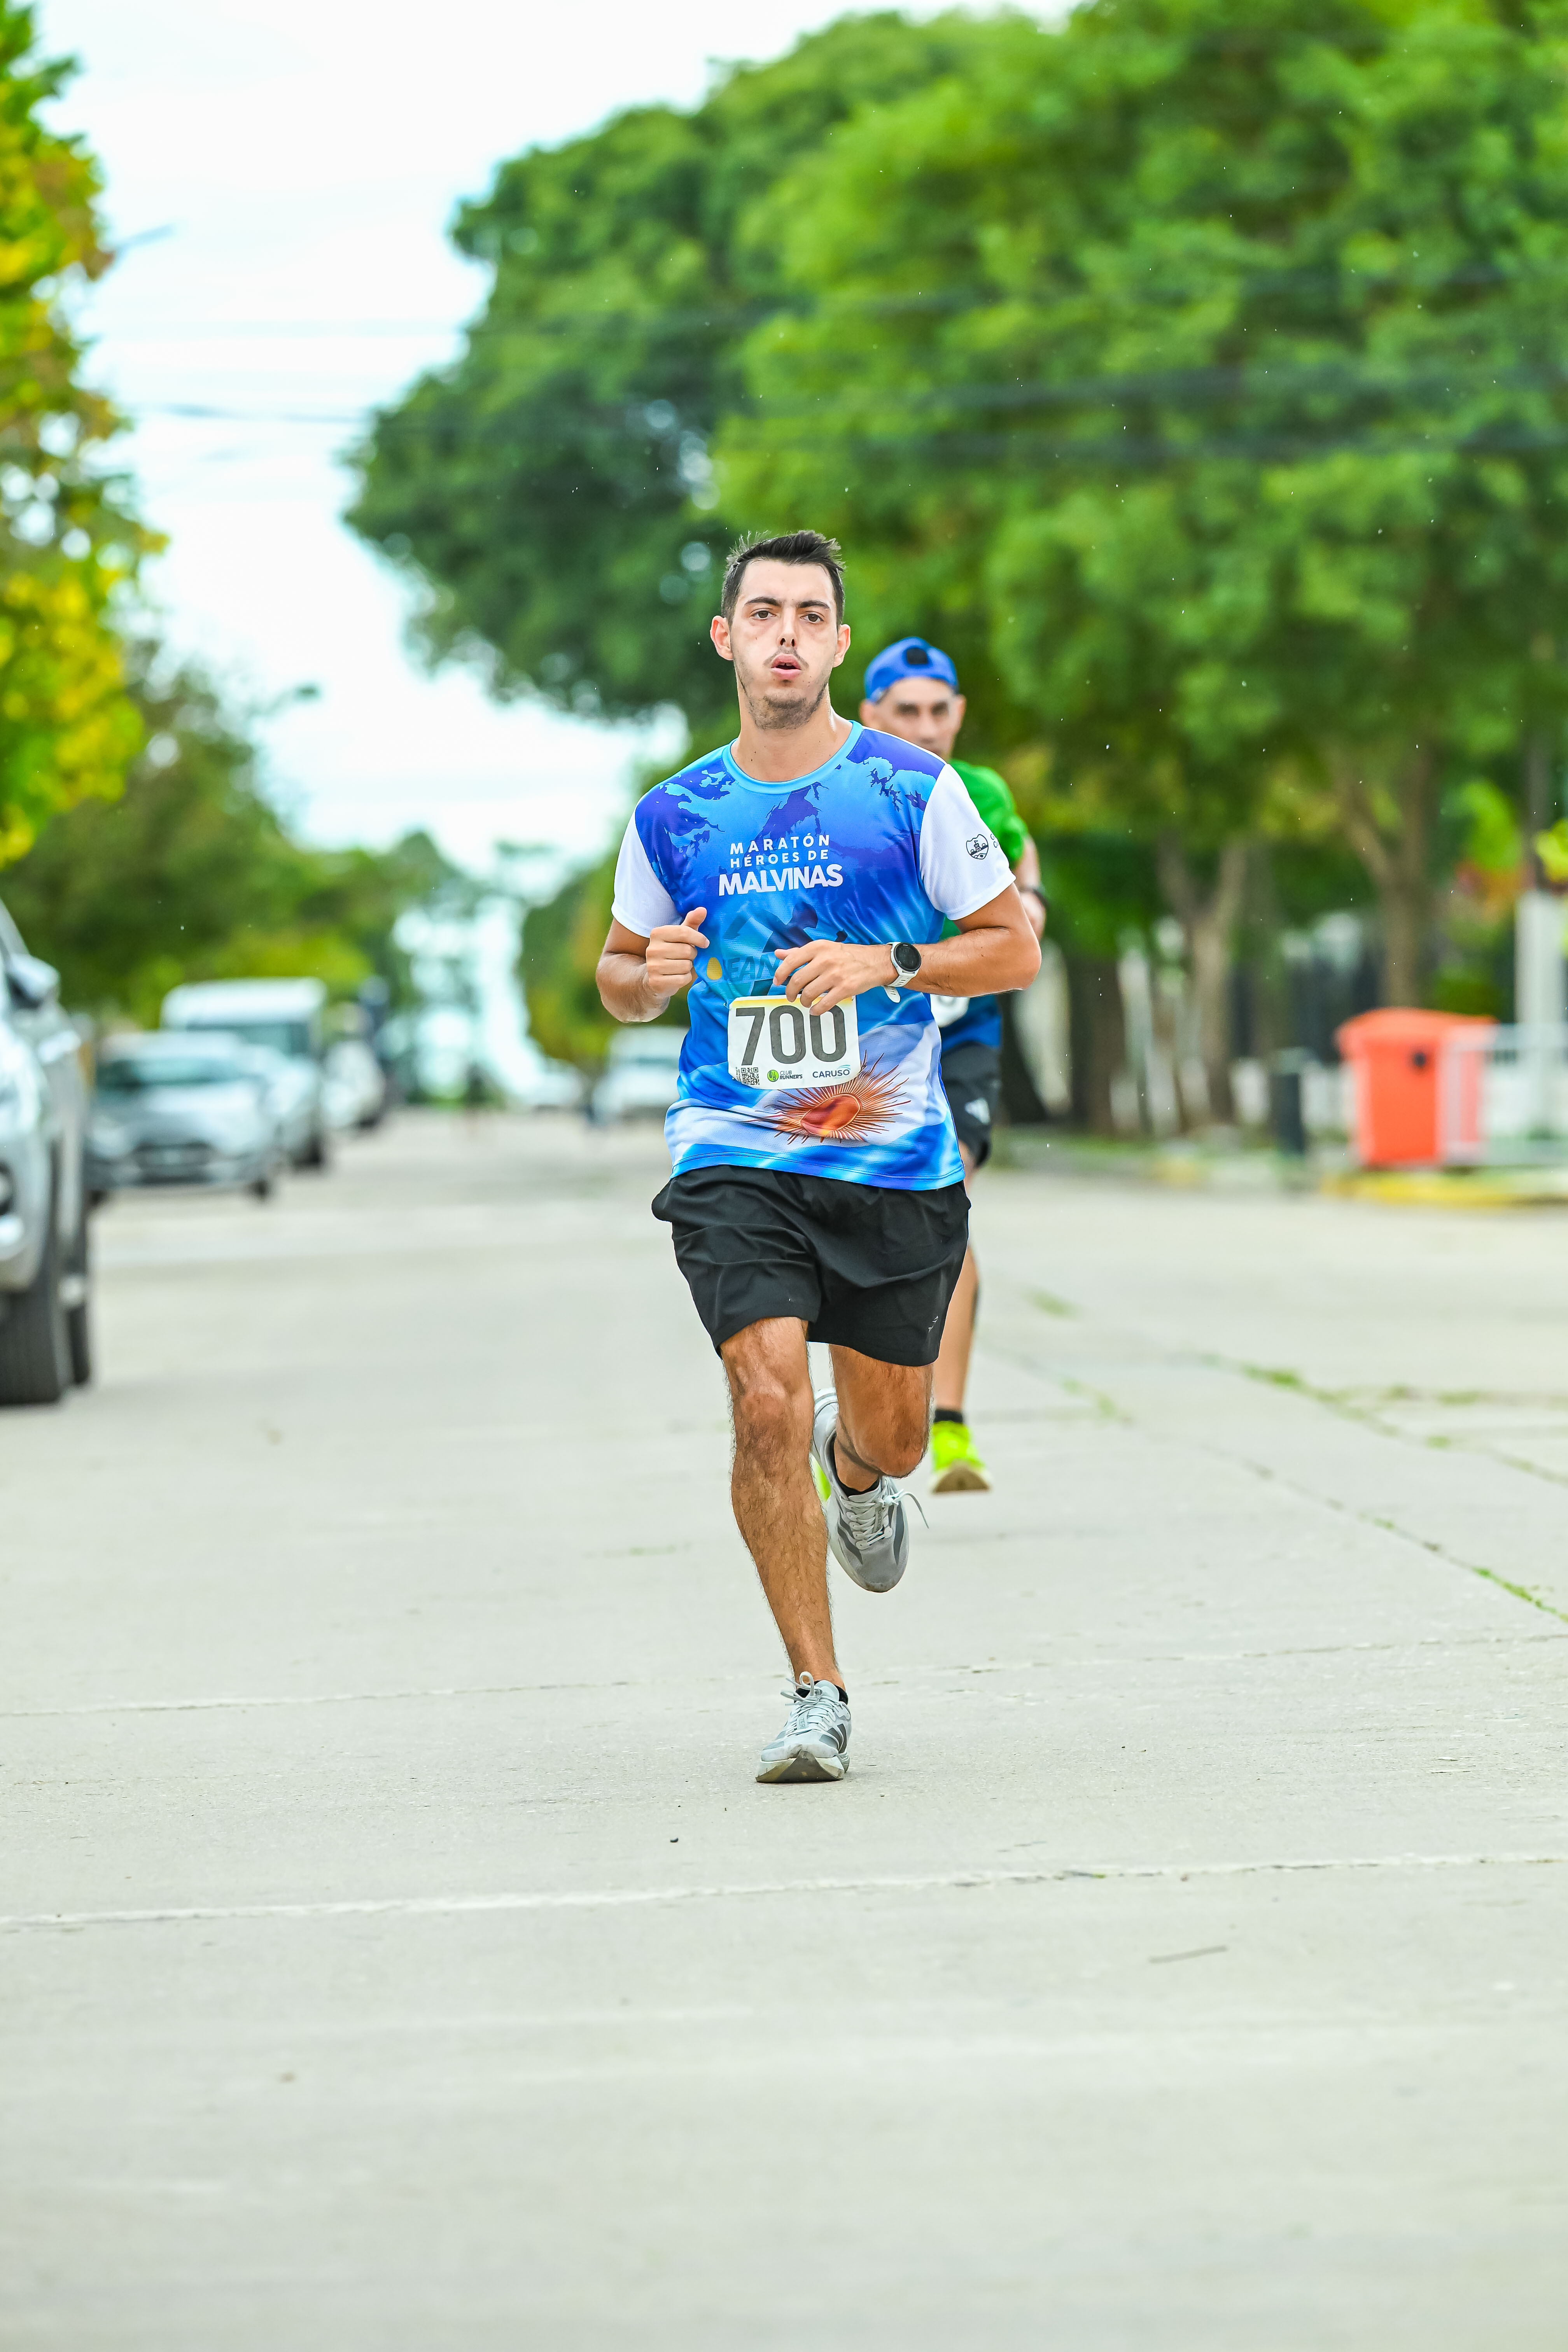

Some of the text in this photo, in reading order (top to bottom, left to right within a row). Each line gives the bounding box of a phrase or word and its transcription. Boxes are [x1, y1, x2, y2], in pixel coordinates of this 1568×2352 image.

[730, 832, 830, 855] MARATÓN
[730, 849, 828, 868] HÉROES DE
[719, 863, 843, 896] MALVINAS
[735, 1004, 847, 1066] 700
[812, 1069, 850, 1078] CARUSO
